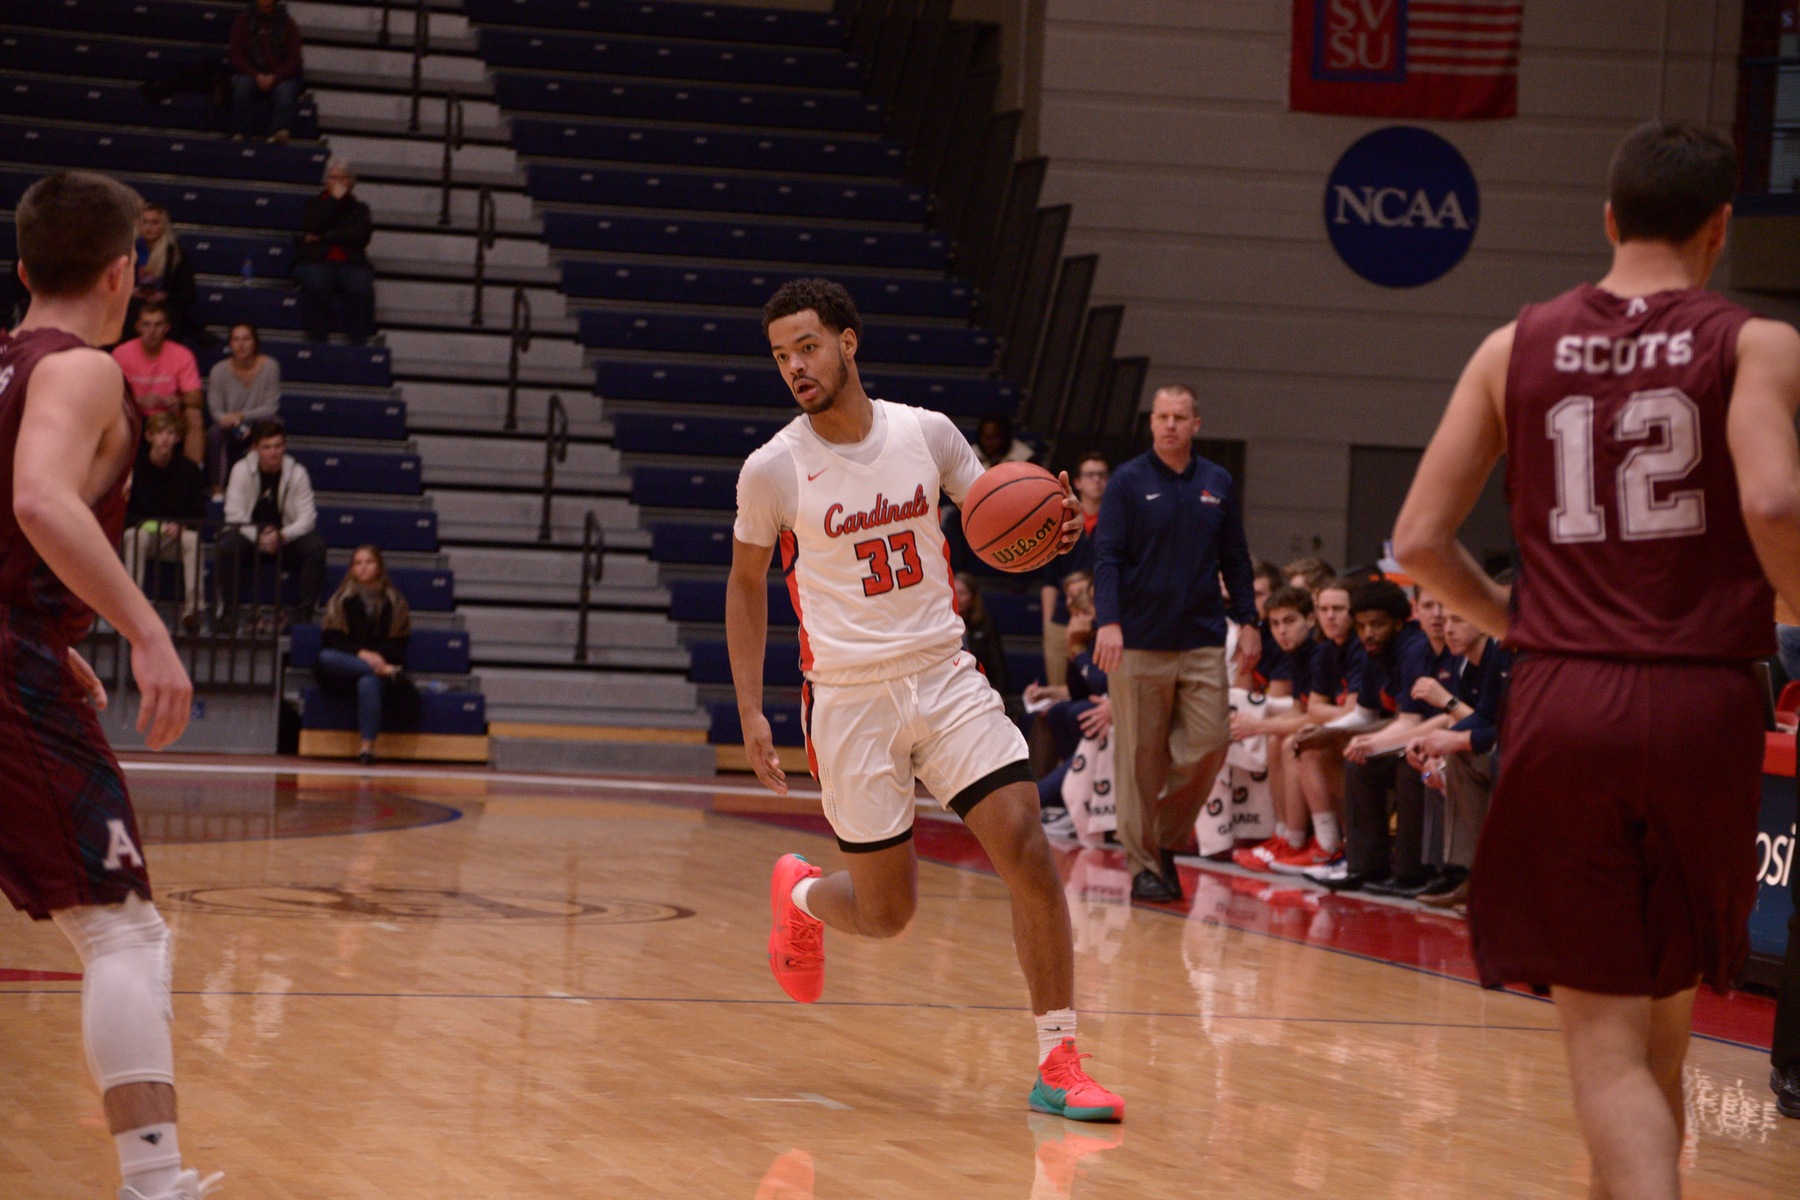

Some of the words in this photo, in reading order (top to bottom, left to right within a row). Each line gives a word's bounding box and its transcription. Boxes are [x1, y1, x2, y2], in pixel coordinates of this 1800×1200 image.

[1329, 31, 1391, 69] SU
[1334, 184, 1470, 231] NCAA
[1553, 329, 1694, 375] SCOTS
[1545, 387, 1707, 544] 12
[823, 483, 930, 538] Cardinals
[853, 529, 924, 598] 33
[991, 516, 1057, 564] Wilson
[102, 818, 144, 870] A
